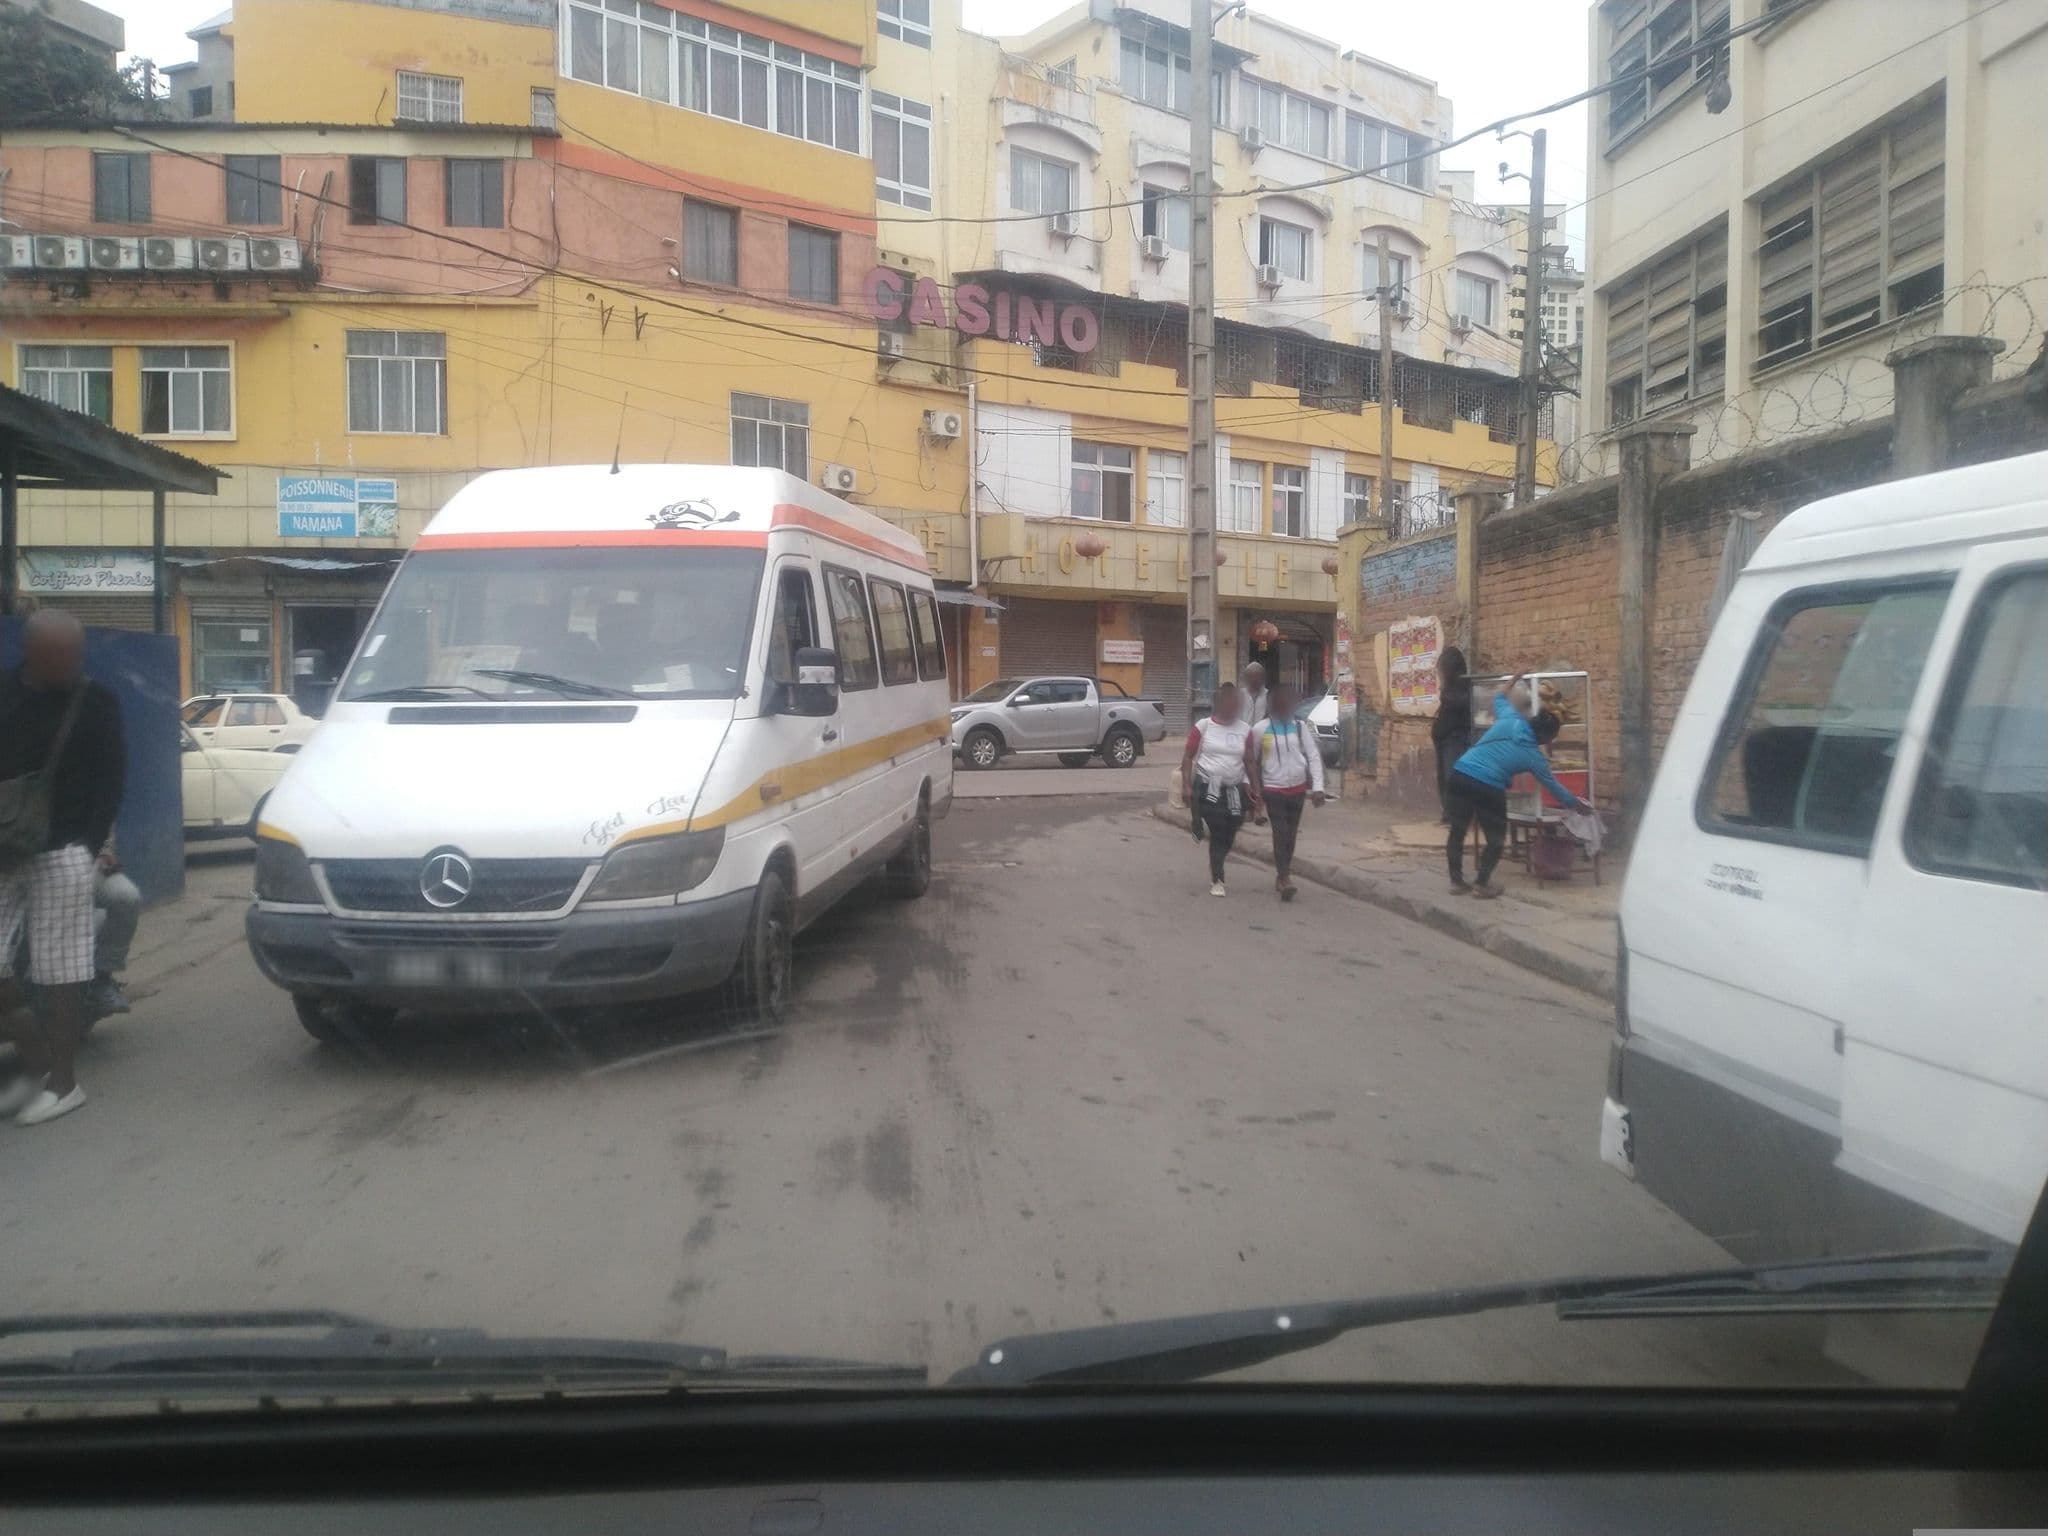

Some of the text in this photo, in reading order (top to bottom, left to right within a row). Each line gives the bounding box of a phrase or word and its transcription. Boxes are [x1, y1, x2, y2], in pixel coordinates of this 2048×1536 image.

[863, 267, 1099, 352] CASINO
[280, 479, 355, 501] POISSONNERIE
[293, 516, 343, 532] NAMANA
[30, 571, 92, 590] Coiffure
